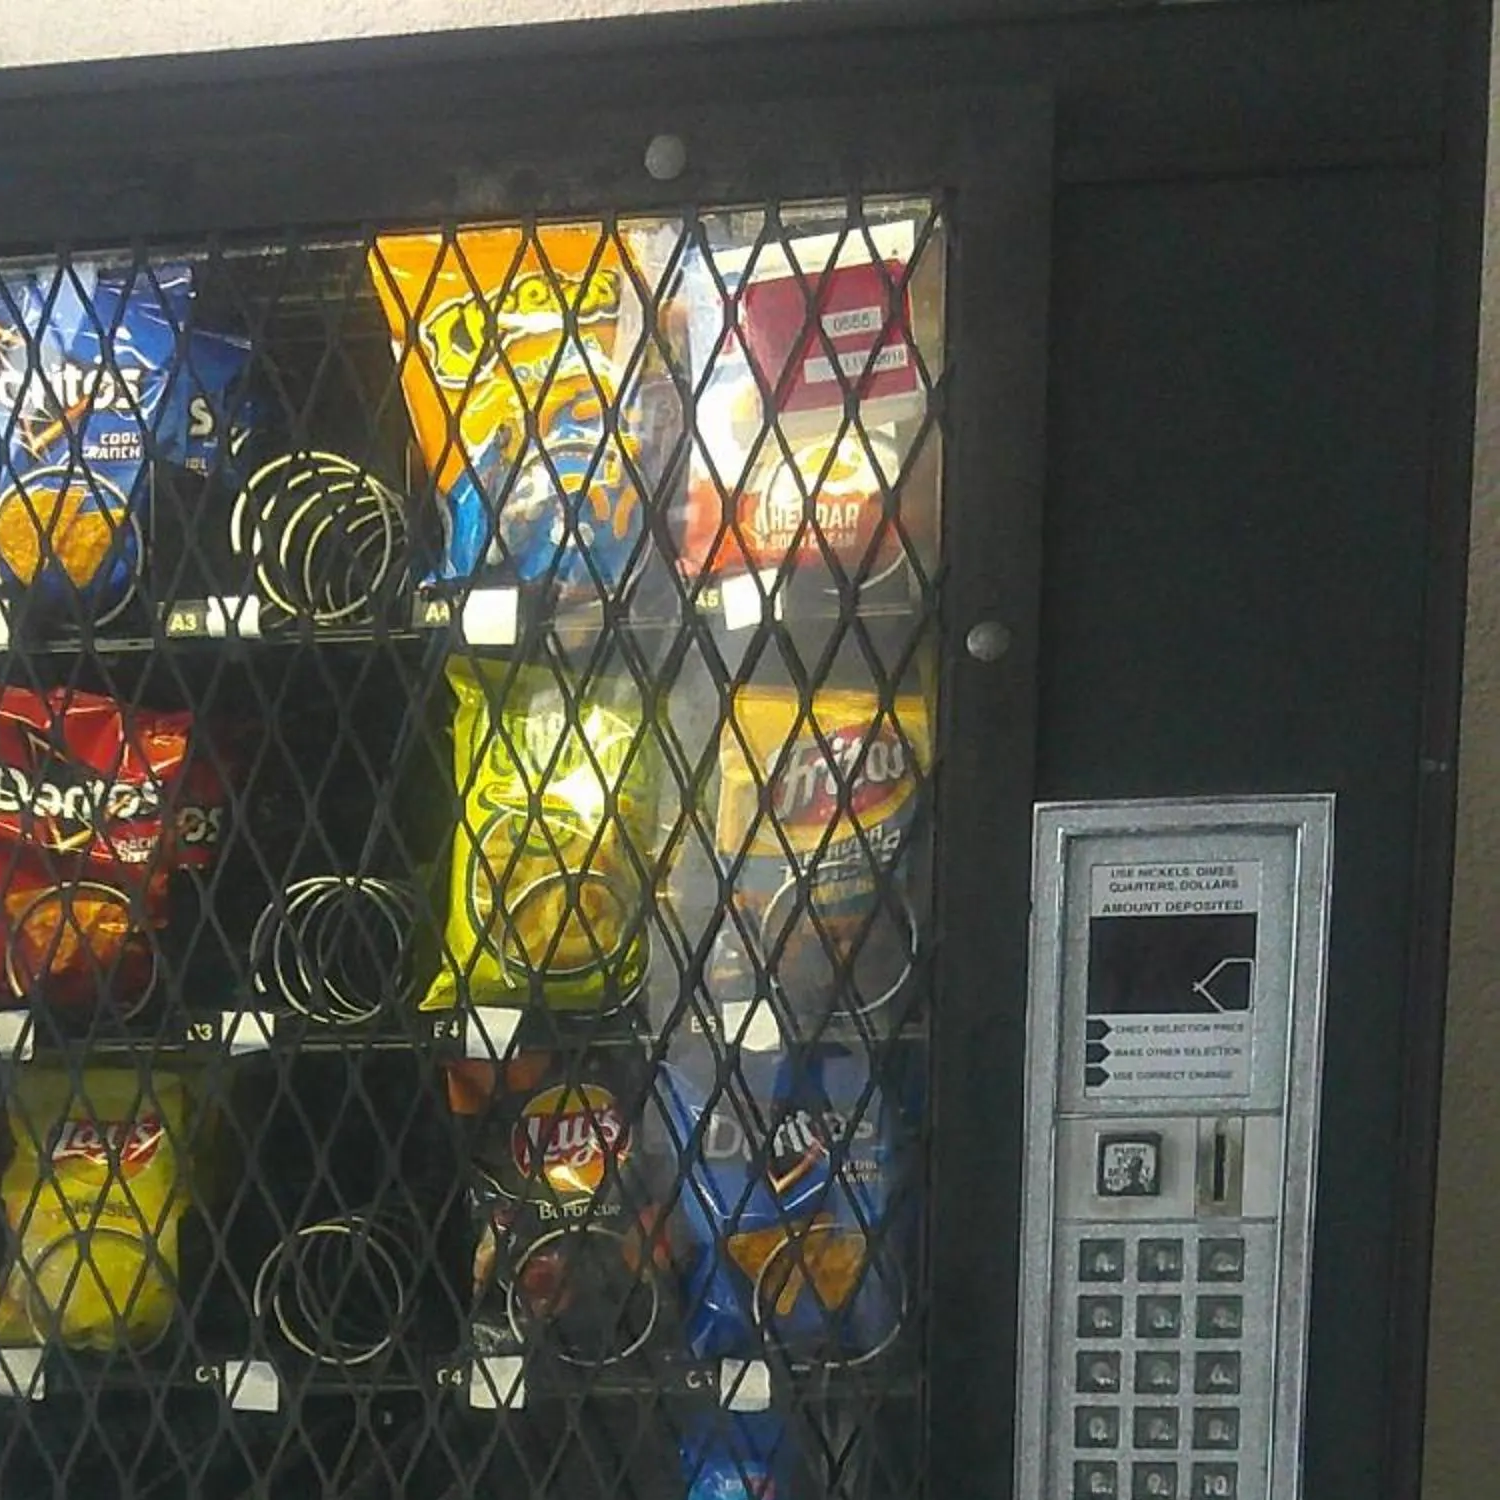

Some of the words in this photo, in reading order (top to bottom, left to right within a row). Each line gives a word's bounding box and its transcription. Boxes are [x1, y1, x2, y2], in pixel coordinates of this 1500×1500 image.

[170, 613, 197, 632] A3
[1179, 879, 1239, 891] DOLLARS
[1102, 901, 1161, 913] AMOUNT
[1165, 899, 1244, 912] DEPOSITED
[1203, 1474, 1227, 1496] 10
